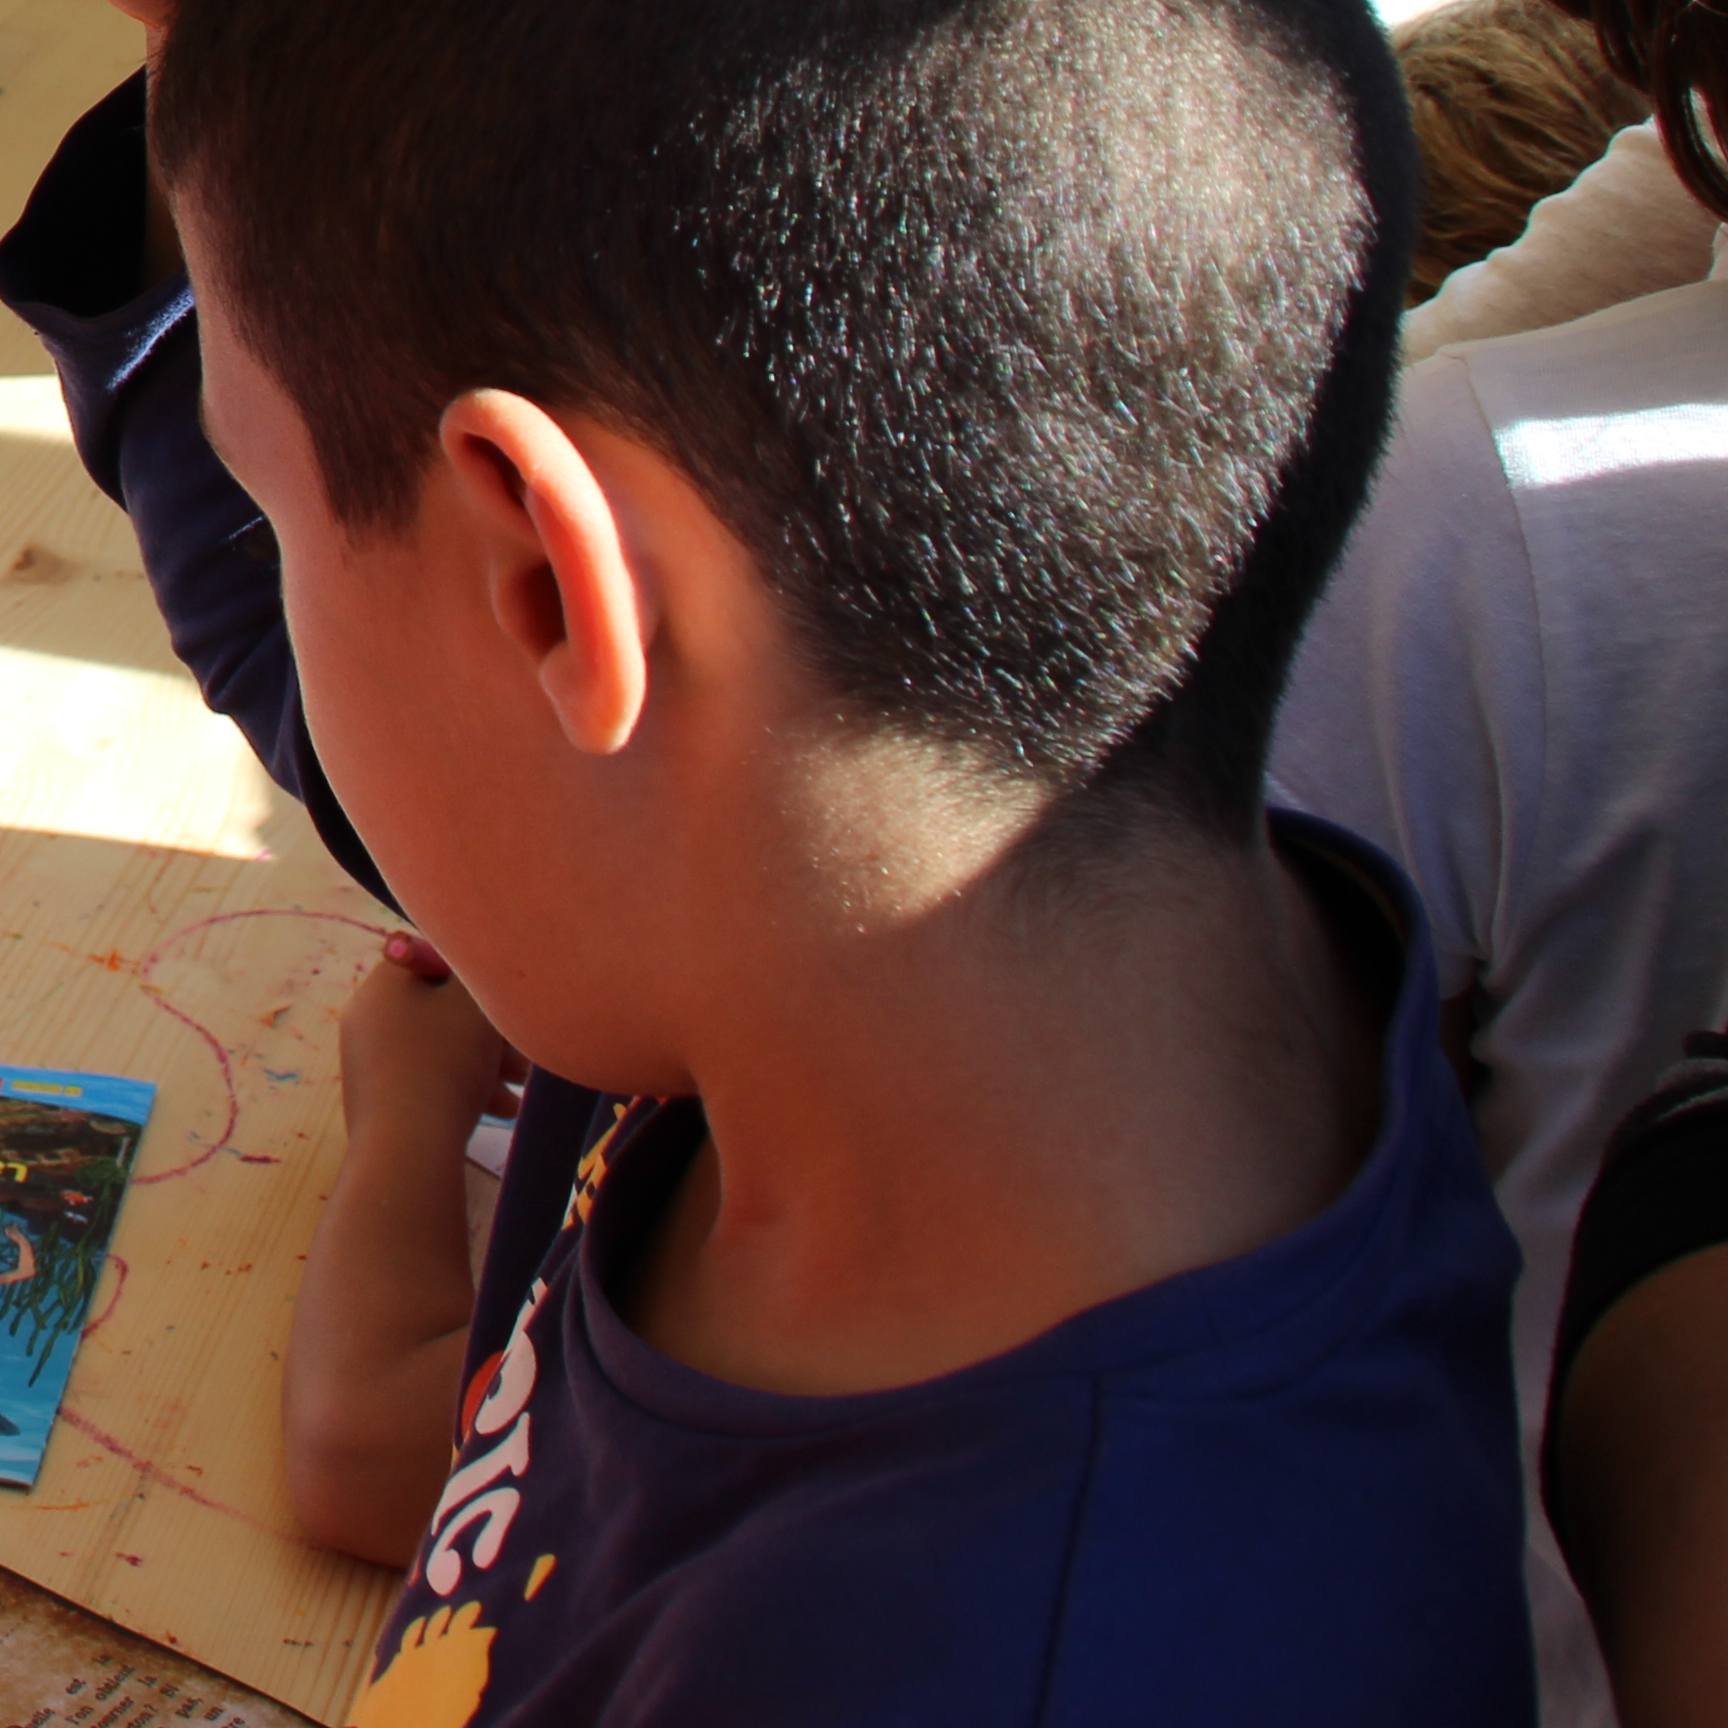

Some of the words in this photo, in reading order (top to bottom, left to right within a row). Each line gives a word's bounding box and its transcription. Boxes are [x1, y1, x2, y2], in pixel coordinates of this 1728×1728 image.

[65, 1678, 87, 1695] est
[95, 1664, 136, 1702] obtient
[137, 1675, 158, 1689] la
[204, 1706, 225, 1722] un
